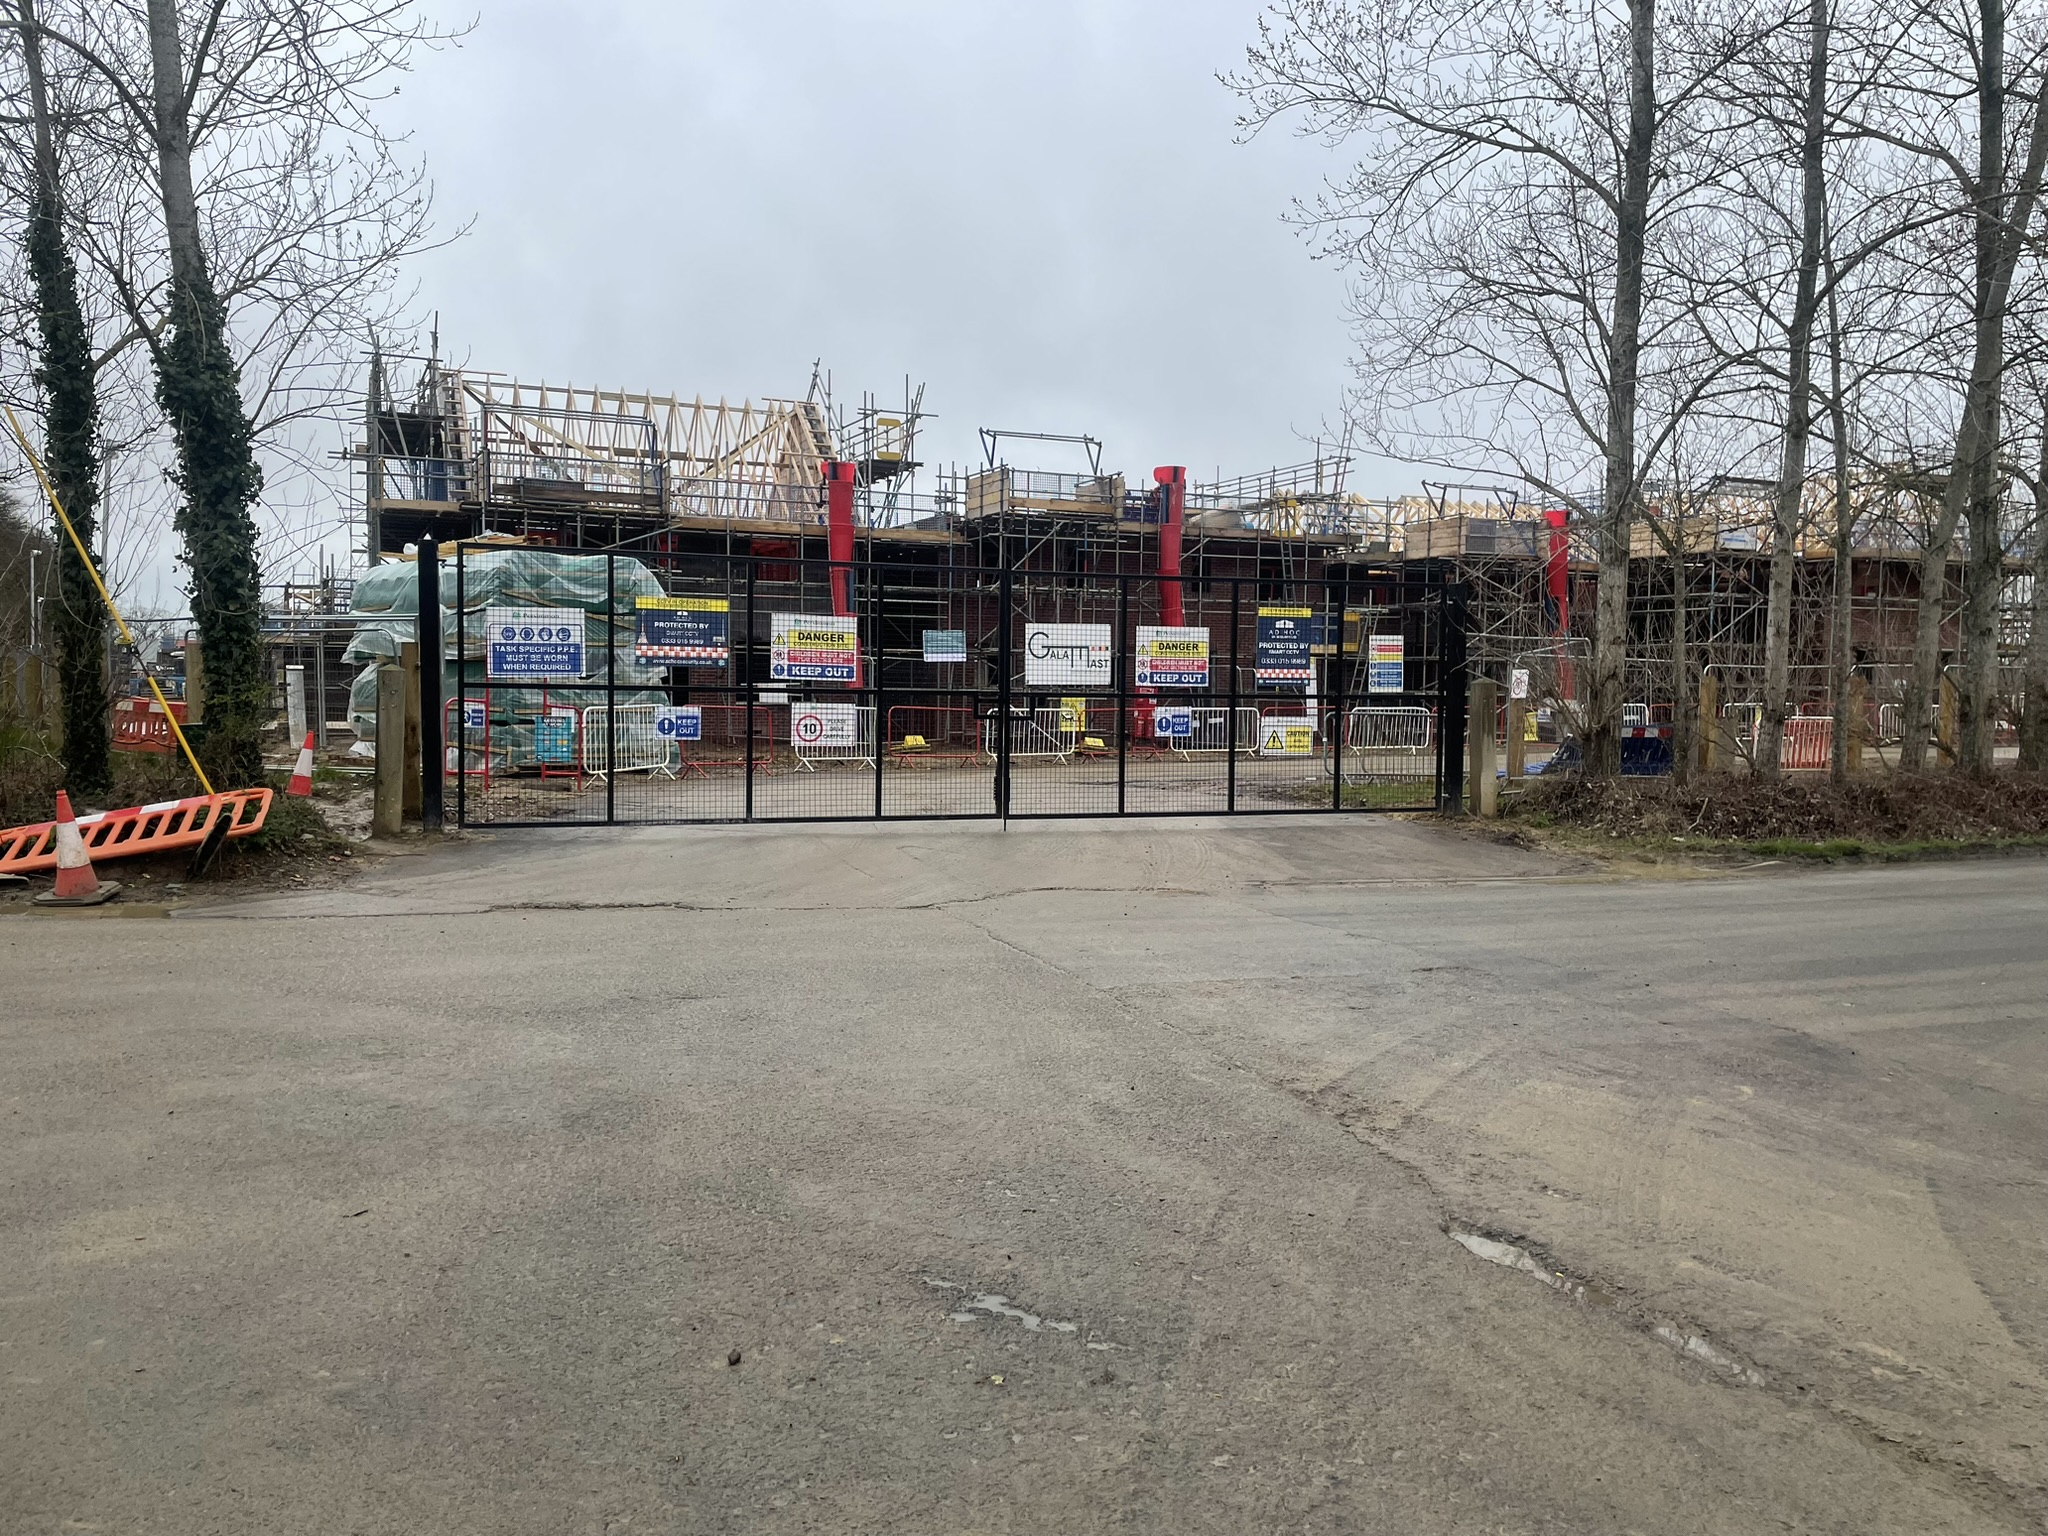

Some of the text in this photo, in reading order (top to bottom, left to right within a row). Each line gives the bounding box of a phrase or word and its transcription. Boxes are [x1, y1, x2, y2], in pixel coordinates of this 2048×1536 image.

[654, 621, 698, 629] PROTECTED
[798, 632, 845, 643] DANGER
[495, 645, 517, 653] TASK
[518, 645, 556, 653] SPECIFIC
[1158, 642, 1199, 651] DANGER
[505, 654, 569, 662] MUST BE WORN
[502, 663, 572, 671] WHEN REQUIRED
[791, 666, 849, 677] KEEP OUT
[1153, 673, 1203, 683] KEEP OUT
[677, 718, 697, 726] KEEP
[803, 723, 817, 735] 10
